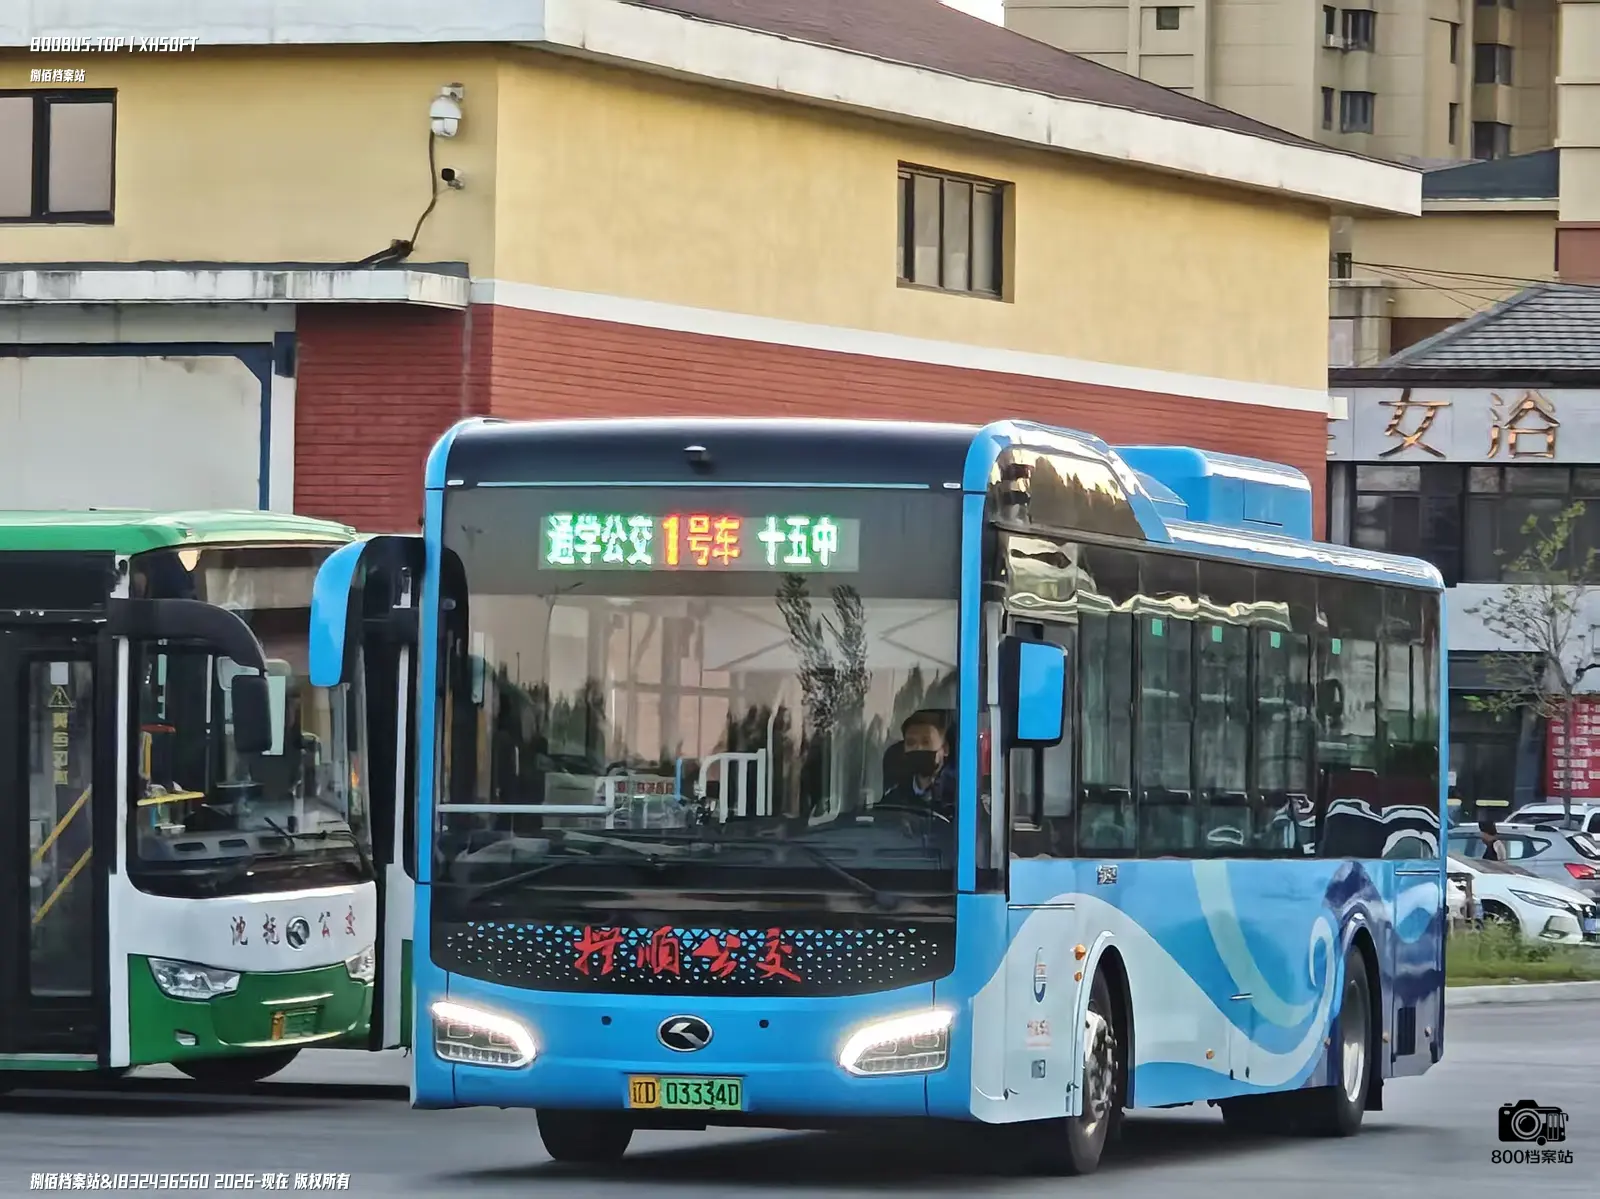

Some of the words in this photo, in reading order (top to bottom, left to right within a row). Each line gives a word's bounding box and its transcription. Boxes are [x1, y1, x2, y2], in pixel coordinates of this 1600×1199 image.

[546, 514, 653, 565] 通学公交
[662, 514, 741, 567] 1号车
[757, 515, 838, 567] 十五中
